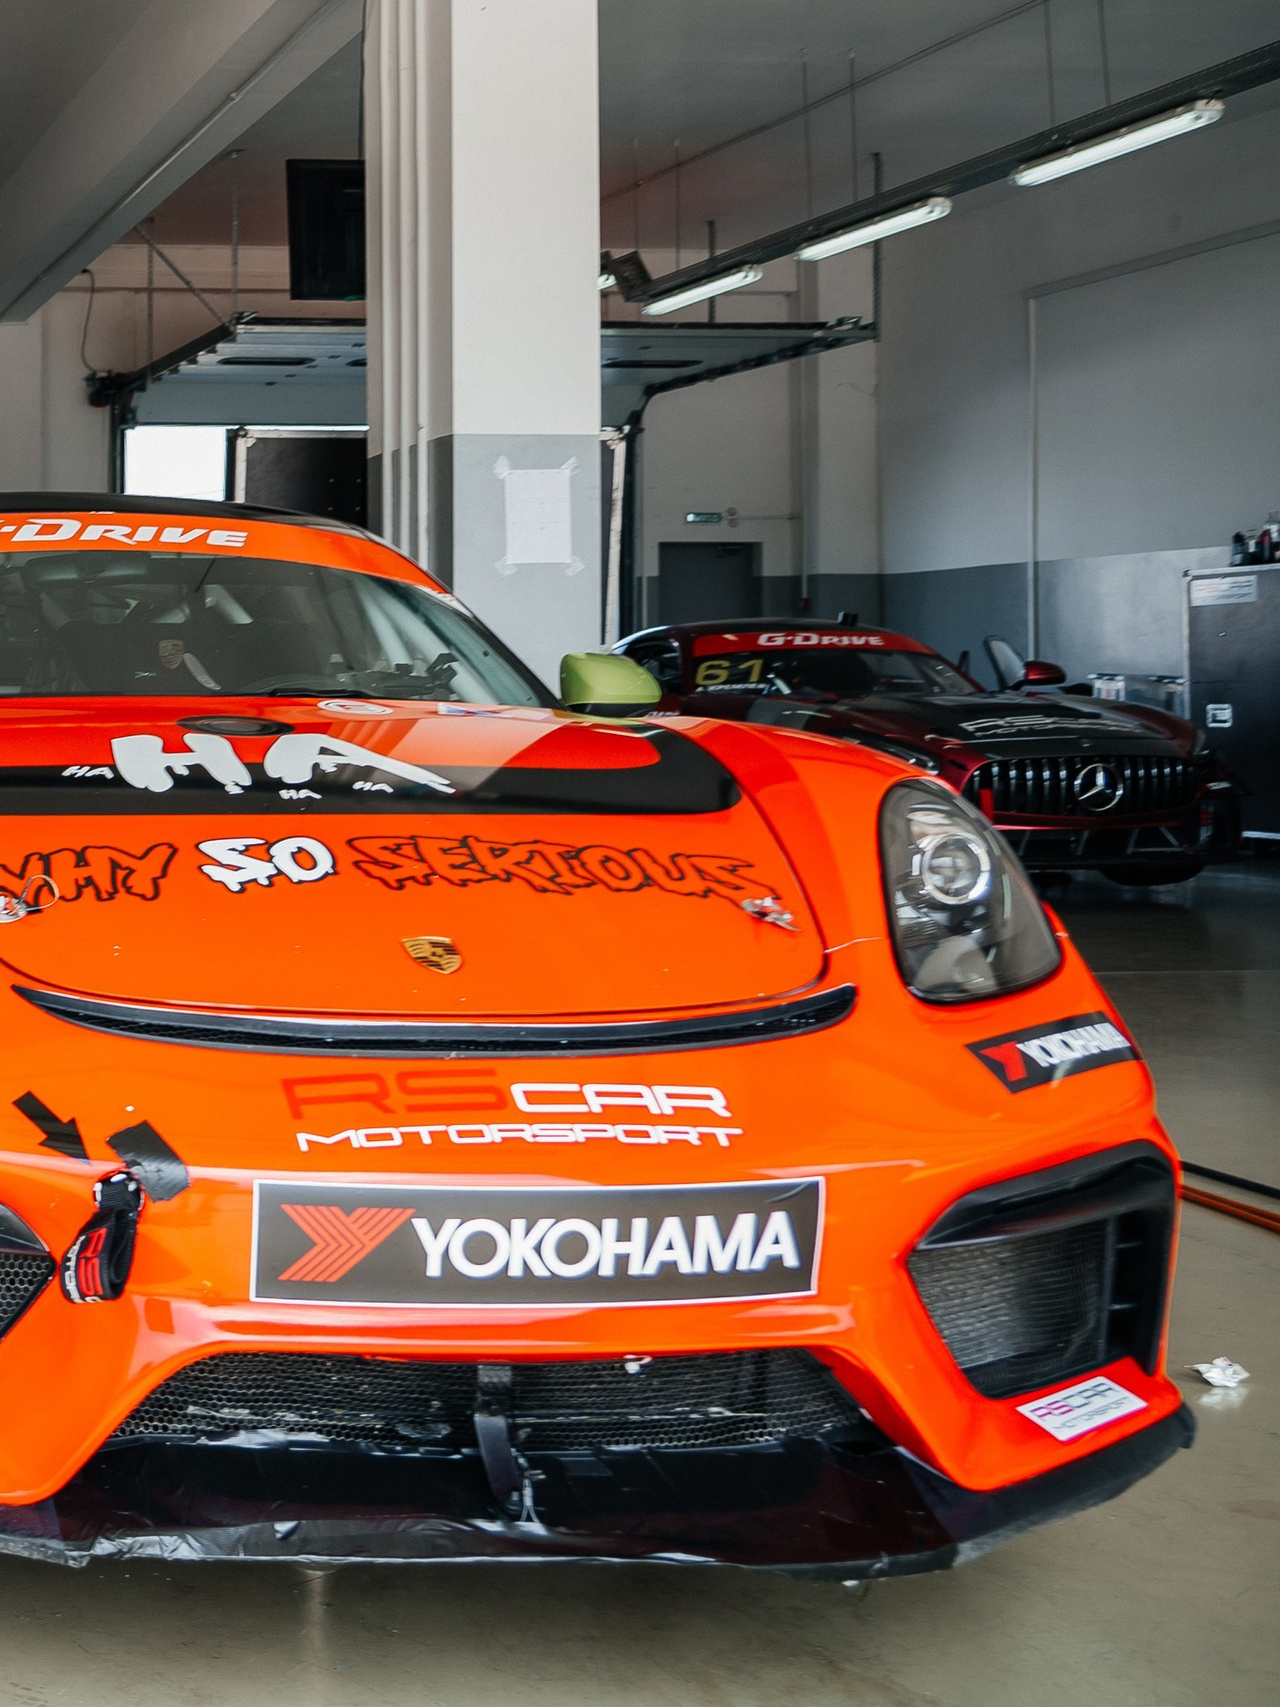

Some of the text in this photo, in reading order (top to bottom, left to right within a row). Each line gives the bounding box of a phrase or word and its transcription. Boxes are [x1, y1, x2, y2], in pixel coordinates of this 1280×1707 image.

[757, 633, 885, 646] G-DRIVE
[695, 659, 764, 686] 61
[61, 765, 114, 779] HA
[195, 836, 338, 893] SO
[346, 835, 782, 904] SERIOUS
[295, 1122, 744, 1152] MOTORSPORT
[410, 1210, 801, 1279] YOKOHAMA
